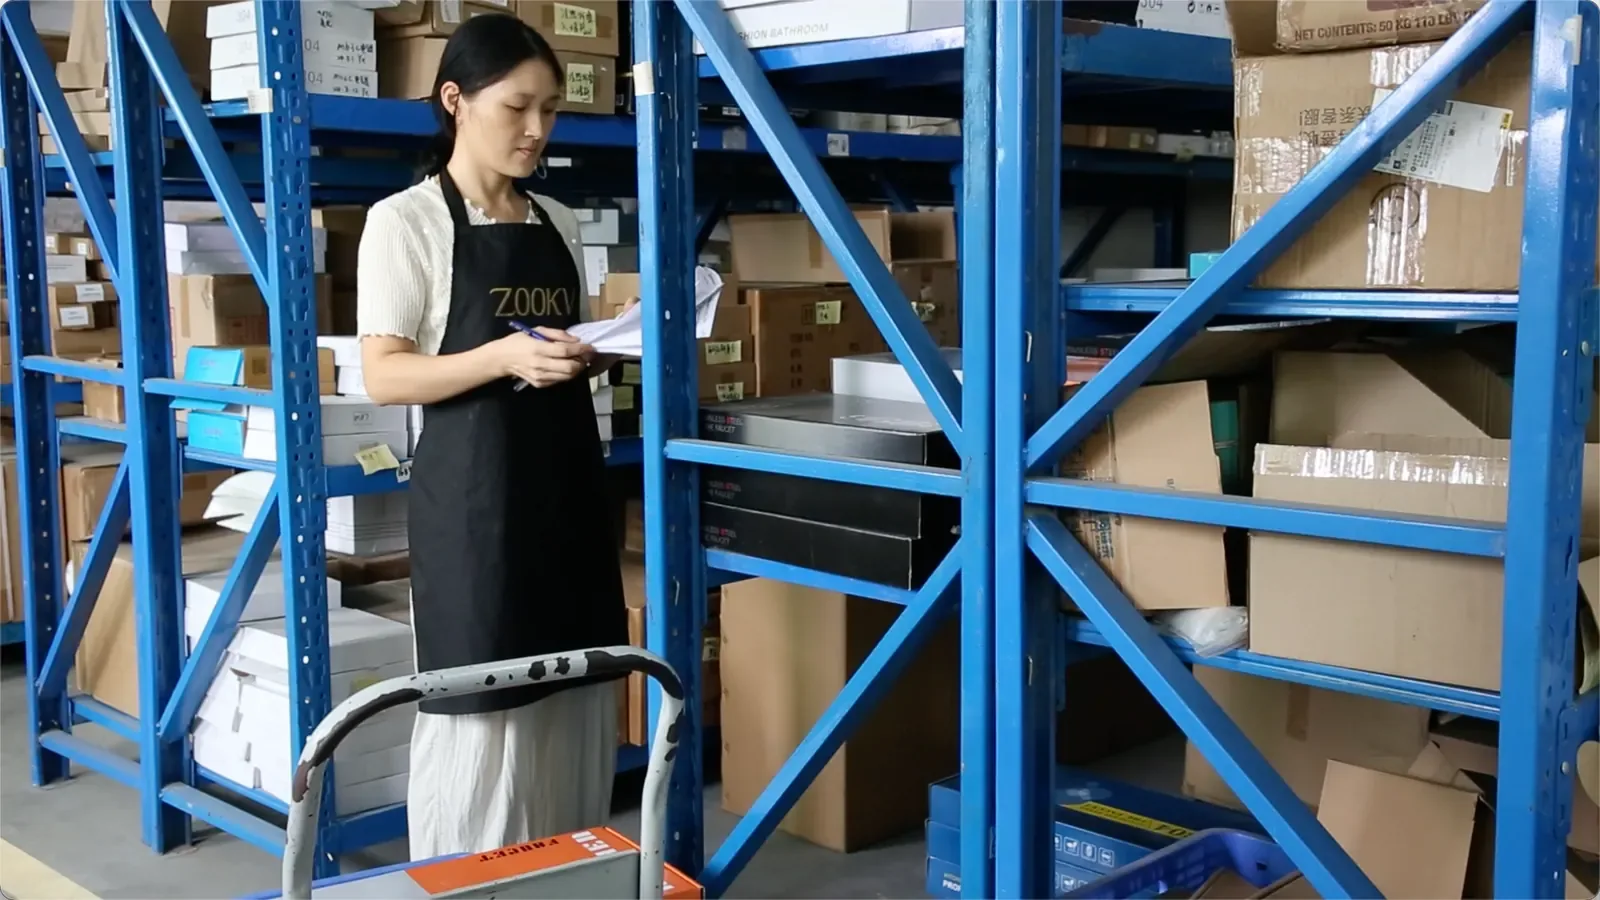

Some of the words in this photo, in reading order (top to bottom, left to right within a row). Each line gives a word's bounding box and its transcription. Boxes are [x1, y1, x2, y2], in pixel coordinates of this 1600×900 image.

[770, 23, 829, 38] BATHROOM
[1295, 29, 1314, 41] NET
[1317, 22, 1377, 38] CONTENTS:
[1379, 20, 1392, 32] 50
